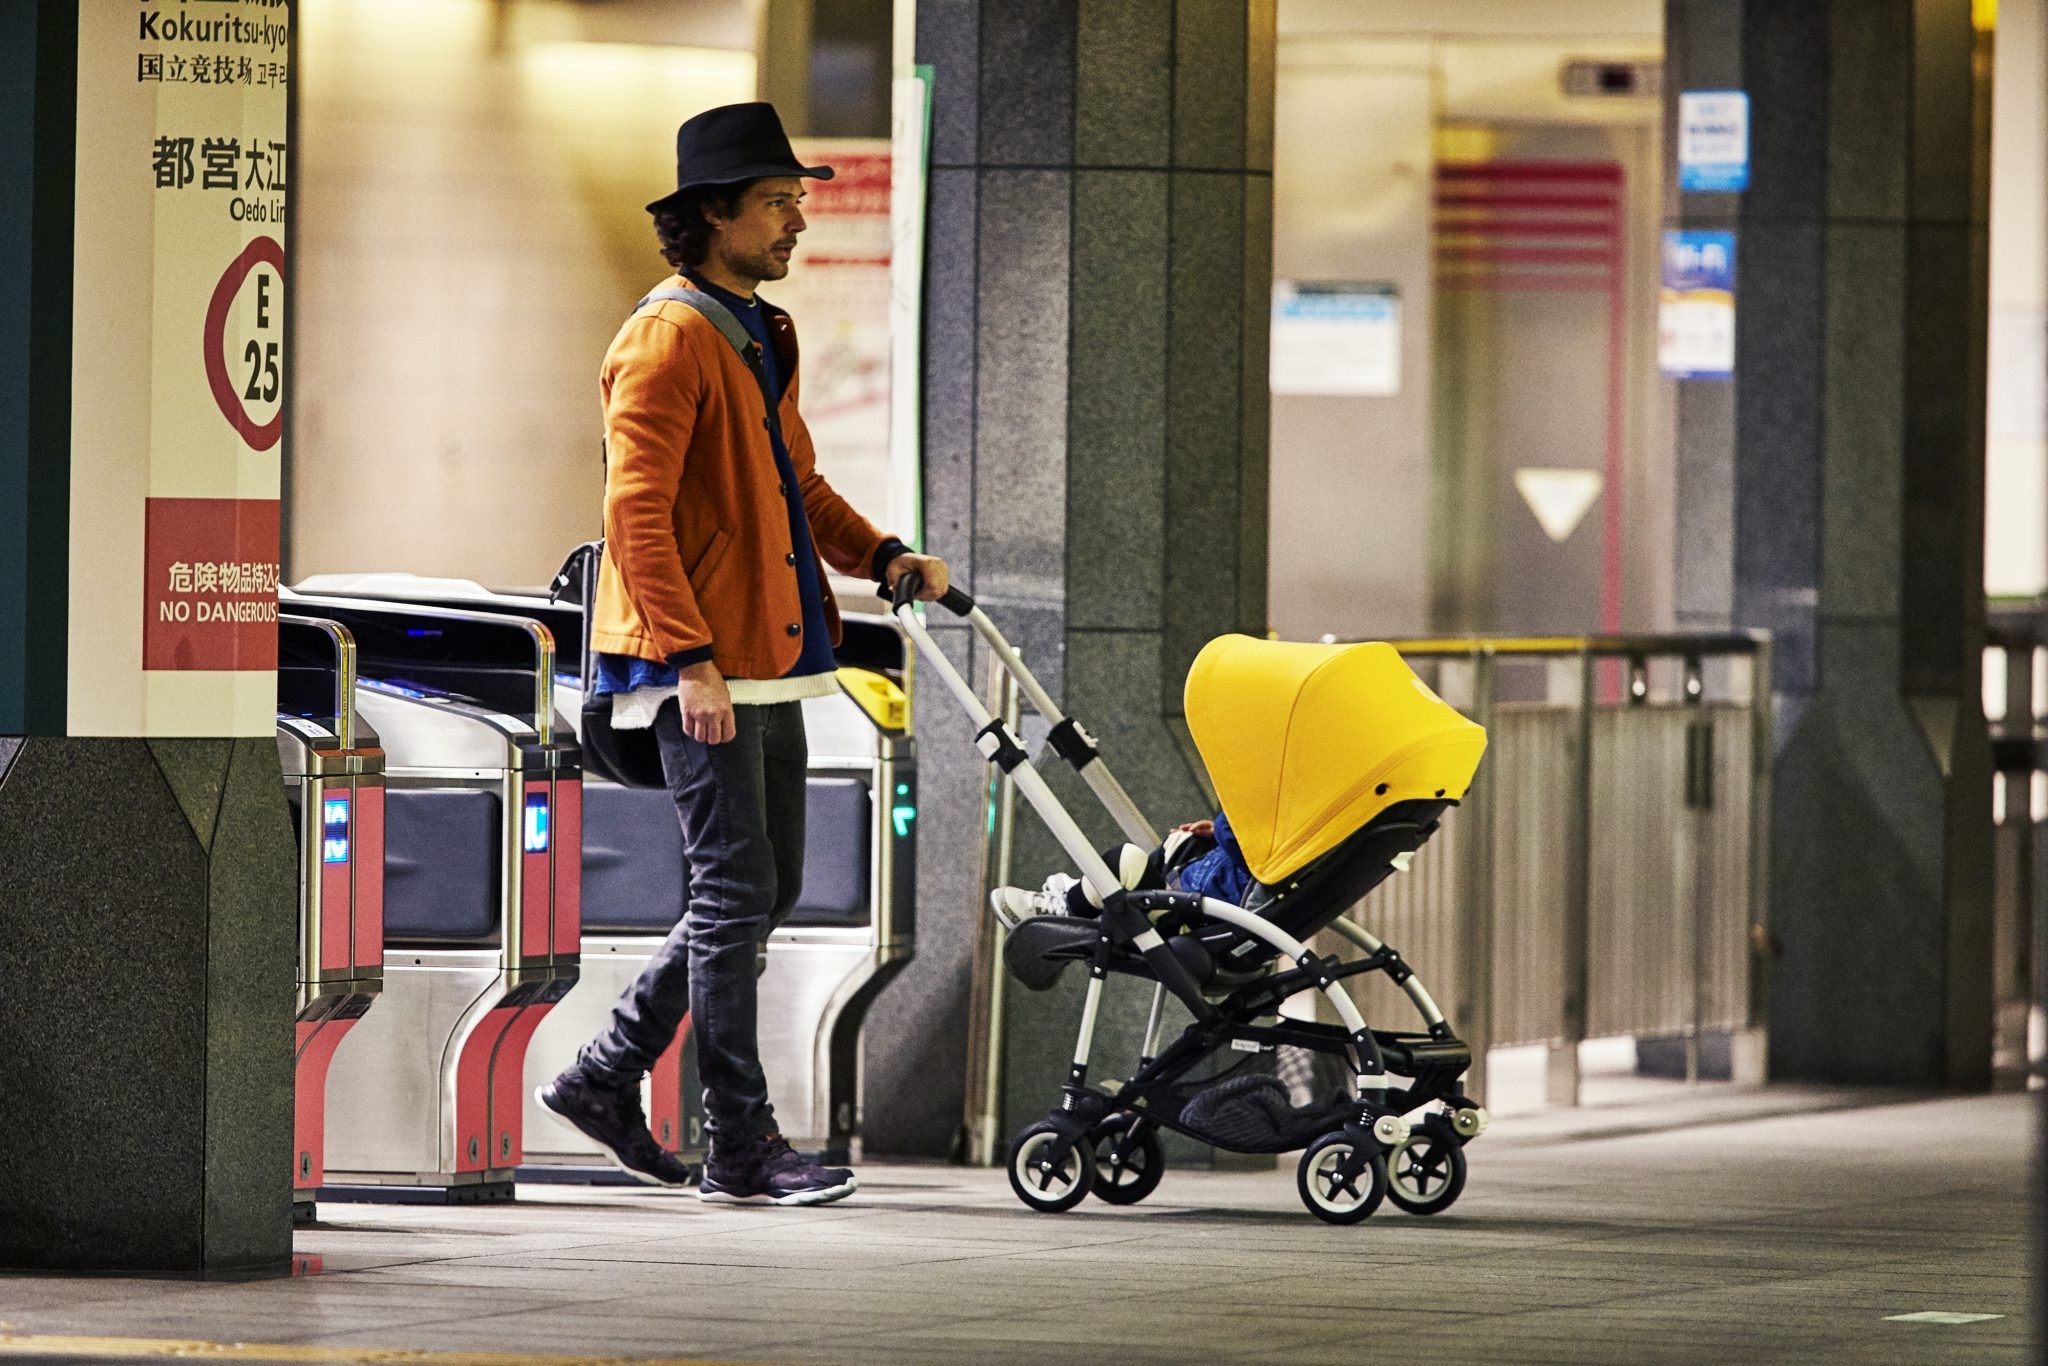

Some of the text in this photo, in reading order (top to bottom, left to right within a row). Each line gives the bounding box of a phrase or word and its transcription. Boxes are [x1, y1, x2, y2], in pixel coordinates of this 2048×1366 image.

[138, 53, 252, 85] 国立竞技场
[152, 136, 286, 191] 都営大江
[229, 197, 267, 222] Oedo
[257, 274, 270, 329] E
[244, 339, 279, 403] 25
[159, 600, 276, 623] NO DANGEROUS
